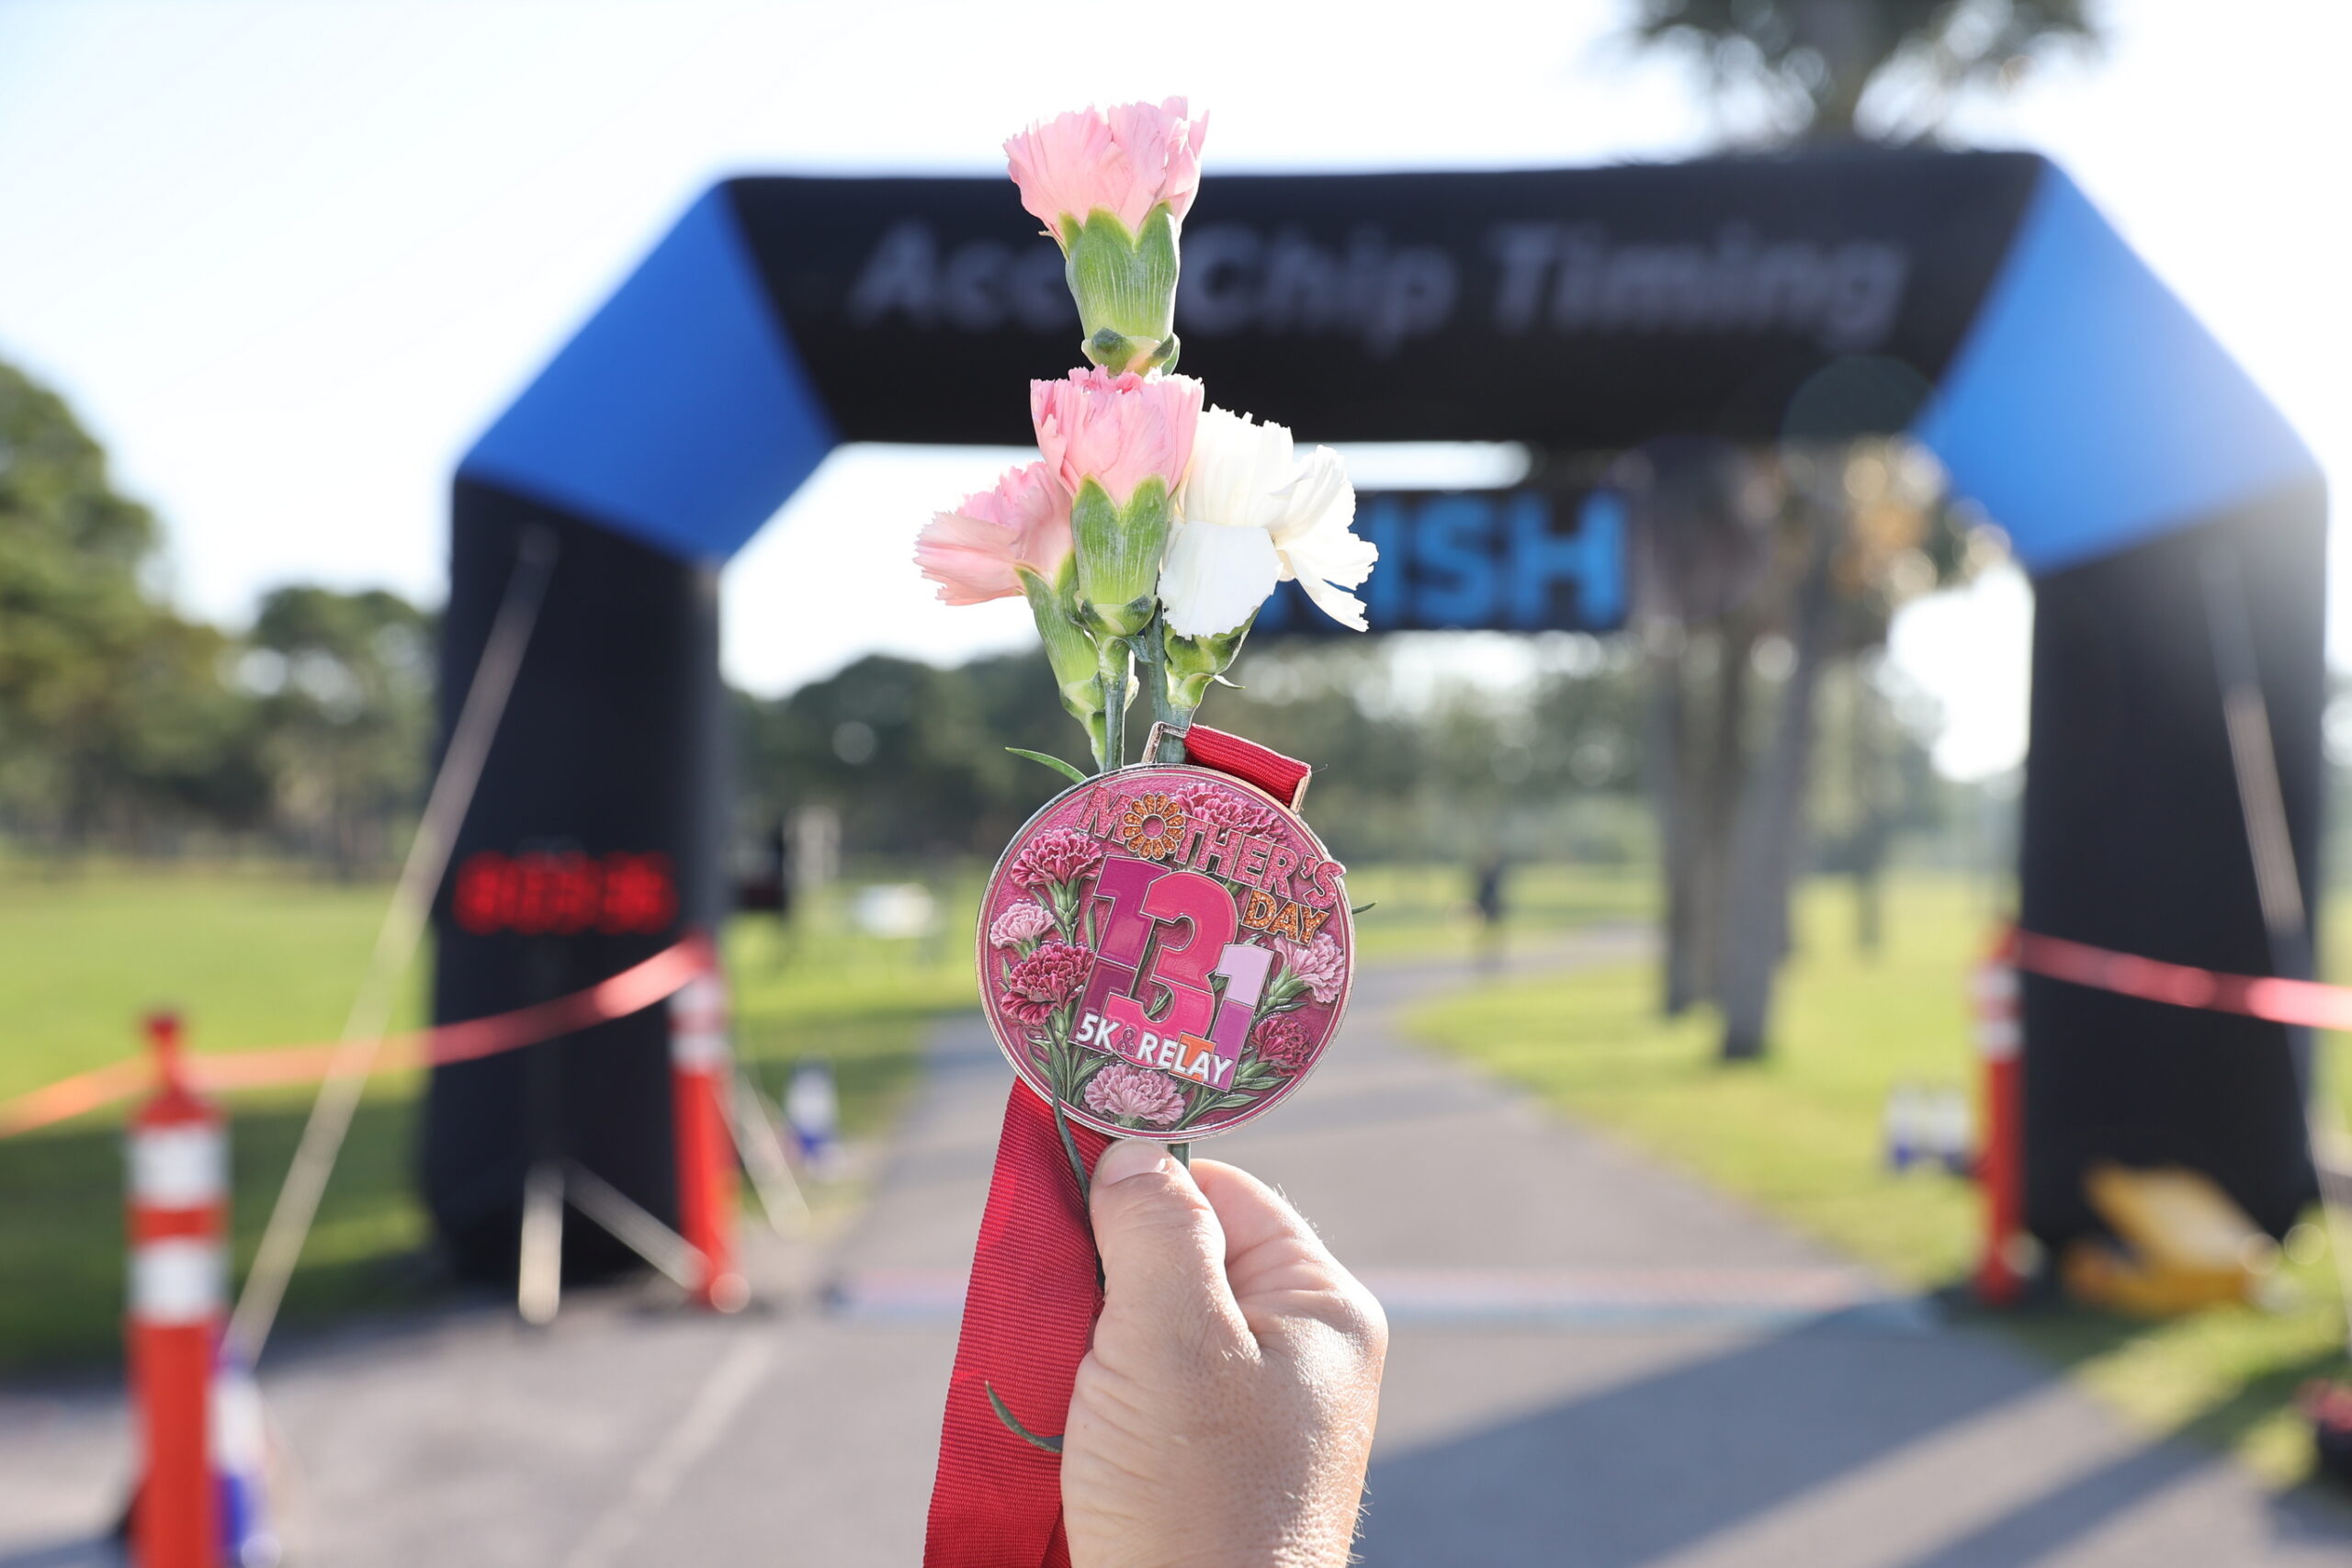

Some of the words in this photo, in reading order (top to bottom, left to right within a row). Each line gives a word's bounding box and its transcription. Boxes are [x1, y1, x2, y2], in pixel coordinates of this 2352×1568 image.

[849, 222, 1459, 353] AccChip
[1485, 222, 1905, 345] Timing
[1076, 786, 1345, 908] MOTHER'S
[1241, 890, 1329, 945] DAY
[1076, 1012, 1120, 1051] 5K
[1136, 1031, 1234, 1085] RELAY
